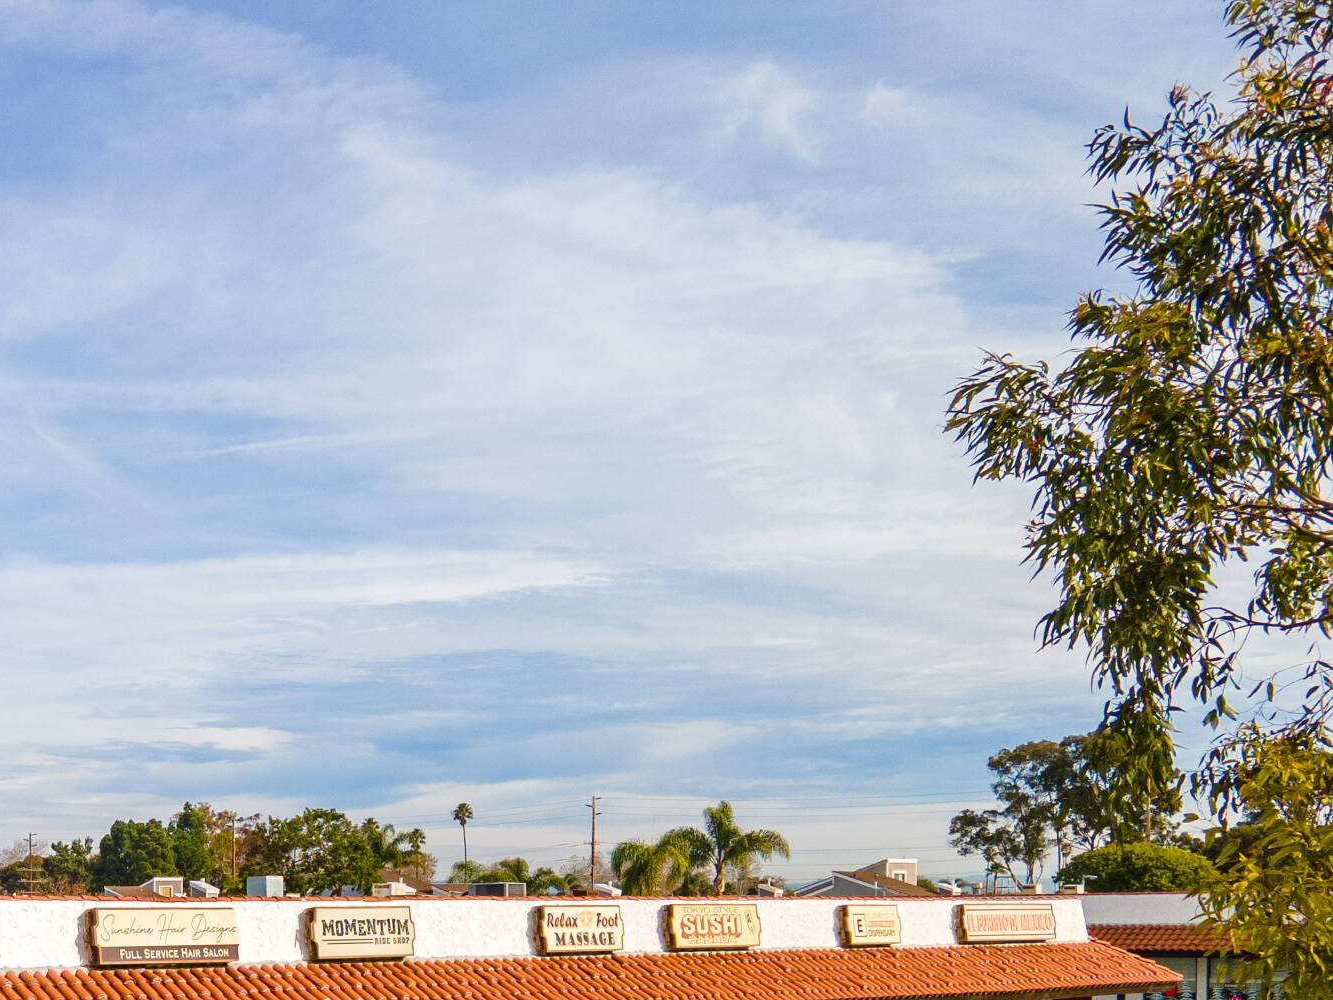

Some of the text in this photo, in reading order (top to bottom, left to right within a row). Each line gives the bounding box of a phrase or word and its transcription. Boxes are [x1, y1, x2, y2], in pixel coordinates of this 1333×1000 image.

[101, 912, 237, 943] Sunshine Hair Designs
[322, 919, 410, 936] MOMENTUM
[547, 913, 619, 928] Relax Foot
[681, 914, 743, 937] SUSHI
[977, 914, 1008, 932] BURRITO
[1021, 913, 1053, 931] MEXICO
[555, 932, 616, 946] MASSAGE
[120, 947, 229, 960] FULL SERVICE HAIR SALON
